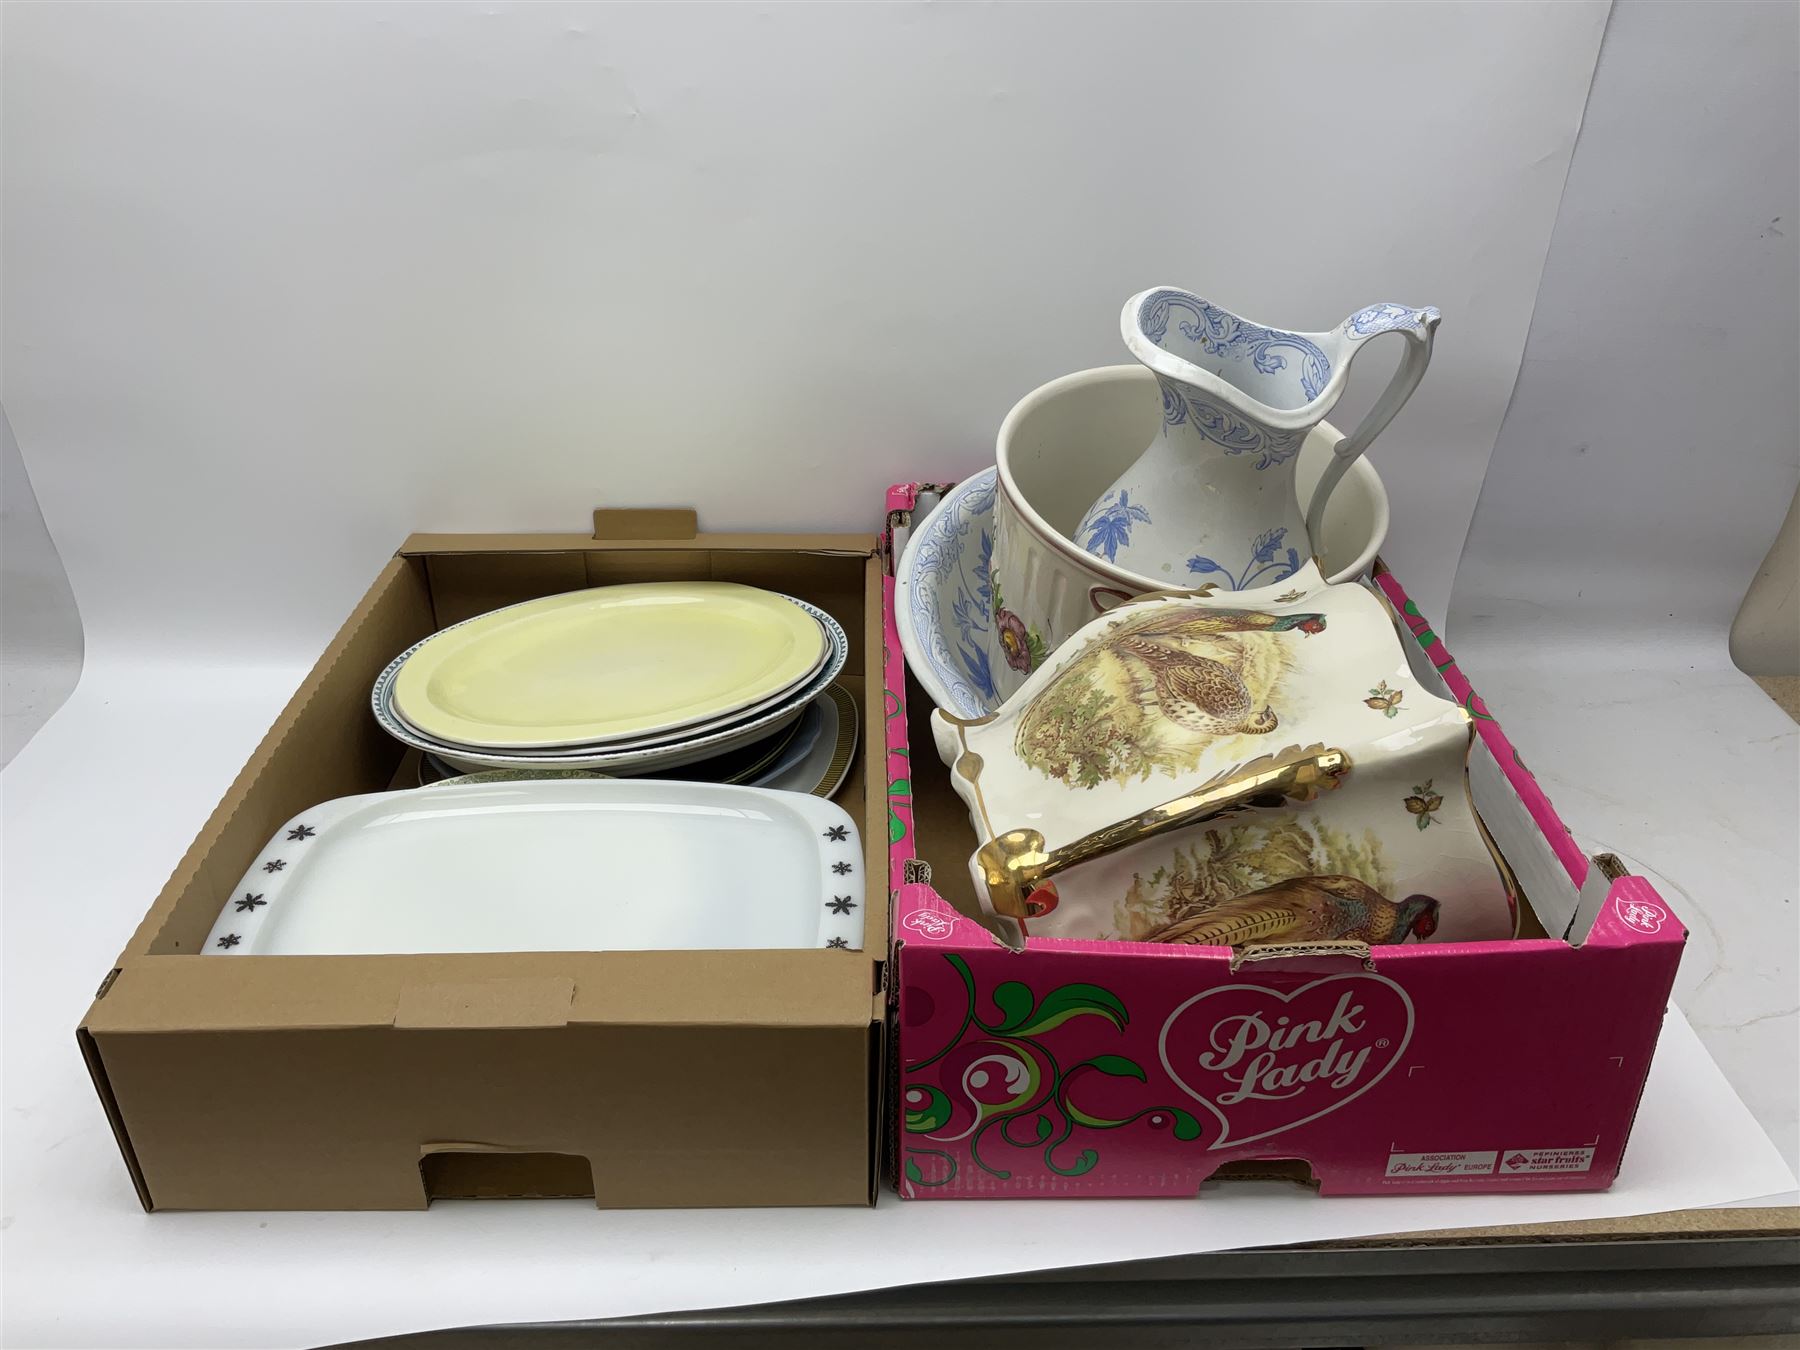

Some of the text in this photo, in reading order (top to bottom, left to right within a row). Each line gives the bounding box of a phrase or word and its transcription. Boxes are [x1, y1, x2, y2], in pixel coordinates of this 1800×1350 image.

[918, 912, 950, 927] Lady
[1624, 904, 1643, 924] Lady
[1641, 906, 1657, 928] Pink
[911, 919, 945, 934] Pink
[1199, 990, 1366, 1070] Pink
[1216, 1038, 1372, 1105] Lady
[1391, 1162, 1424, 1173] Pink
[1464, 1163, 1492, 1171] EUROPE
[1530, 1157, 1554, 1165] star
